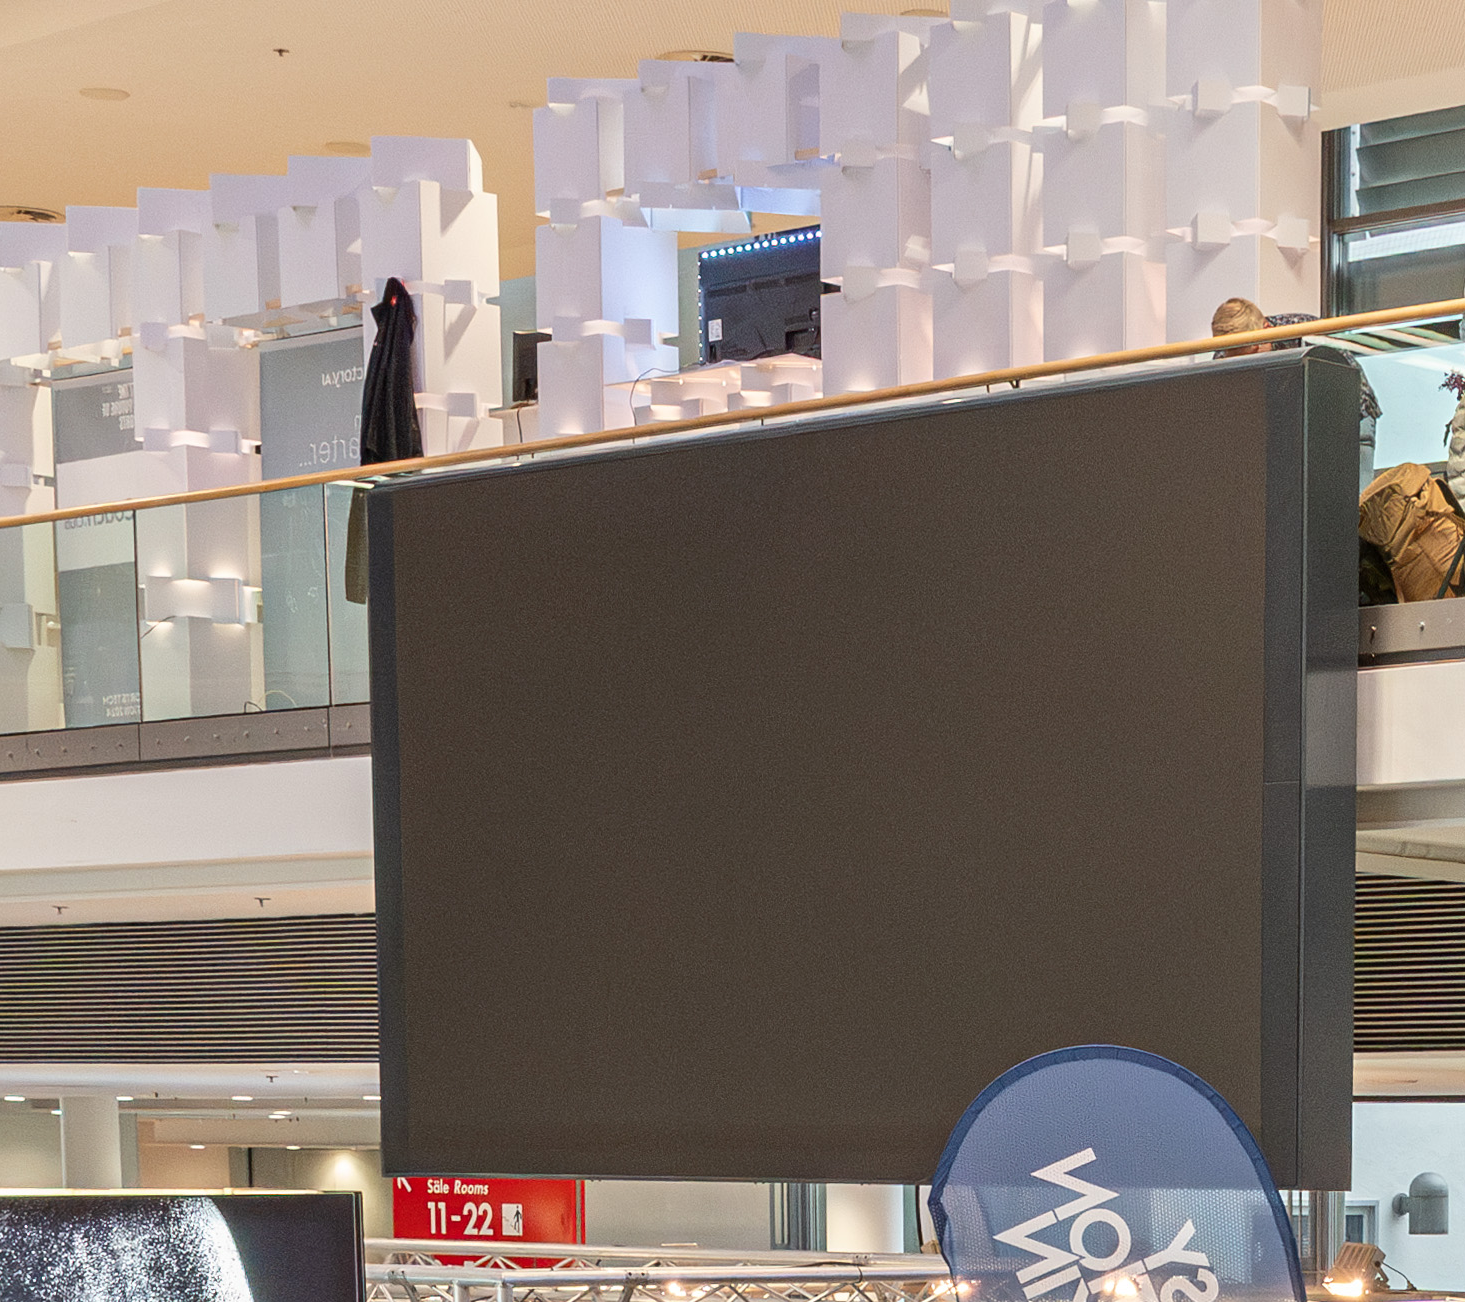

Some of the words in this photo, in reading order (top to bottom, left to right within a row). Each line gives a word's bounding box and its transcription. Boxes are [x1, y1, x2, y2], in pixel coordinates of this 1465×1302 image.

[426, 1178, 450, 1195] Säle
[453, 1180, 490, 1196] Rooms
[426, 1201, 495, 1236] 11-22
